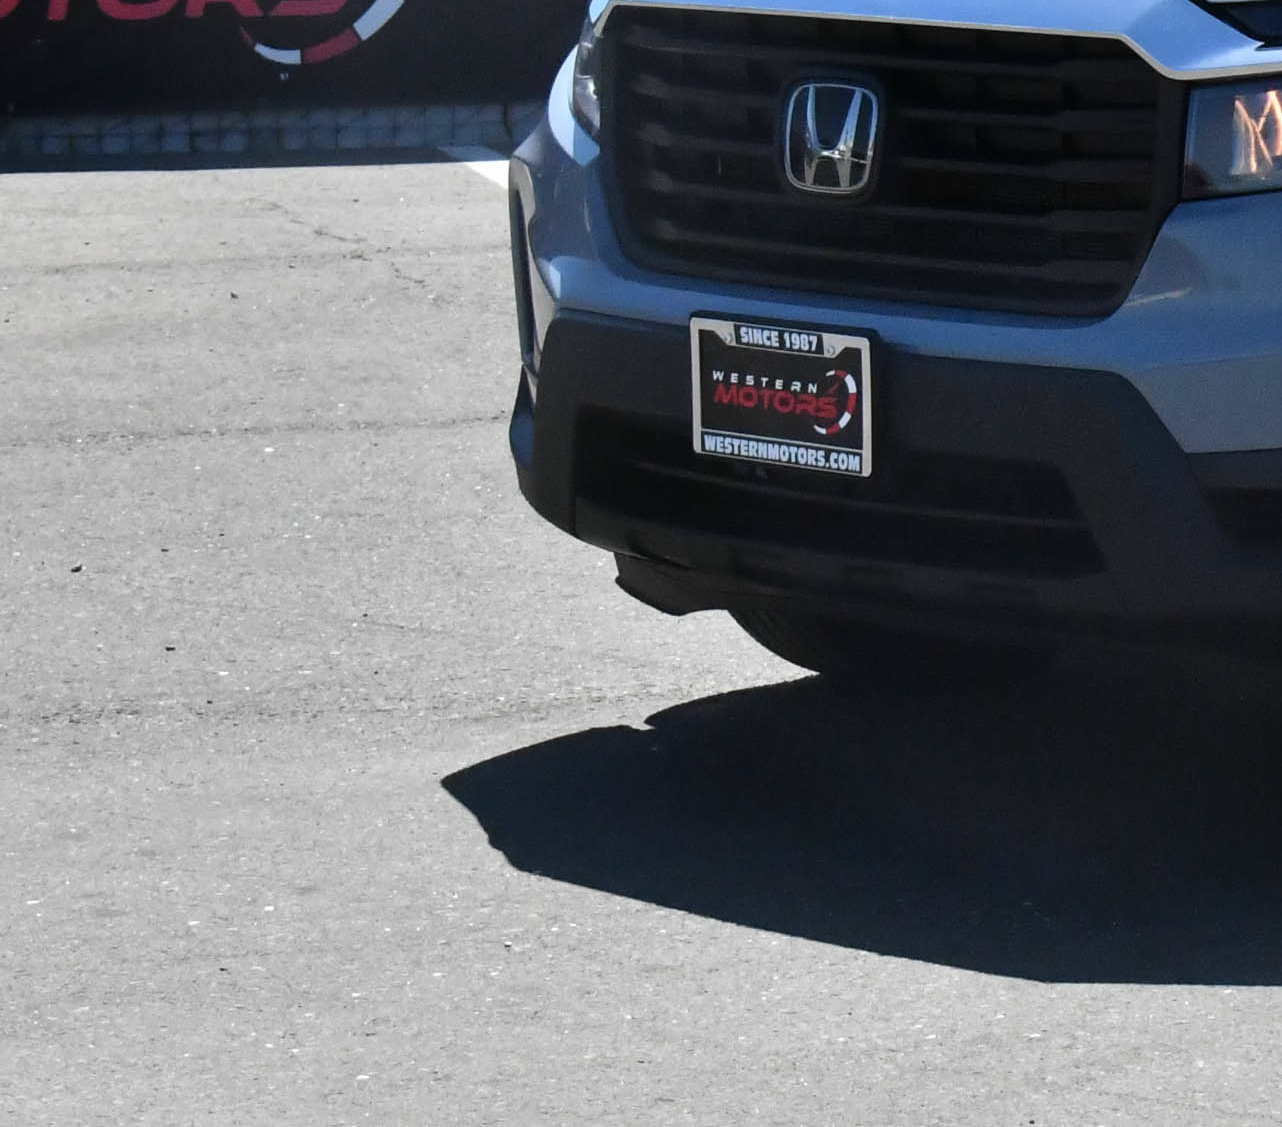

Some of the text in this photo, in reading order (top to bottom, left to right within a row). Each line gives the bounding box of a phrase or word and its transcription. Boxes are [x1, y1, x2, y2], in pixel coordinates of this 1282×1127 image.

[739, 327, 819, 352] SINCE 1987
[712, 370, 818, 394] WESTERN
[713, 383, 840, 418] MOTORS
[703, 434, 861, 472] WESTERNMOTORS.COM
